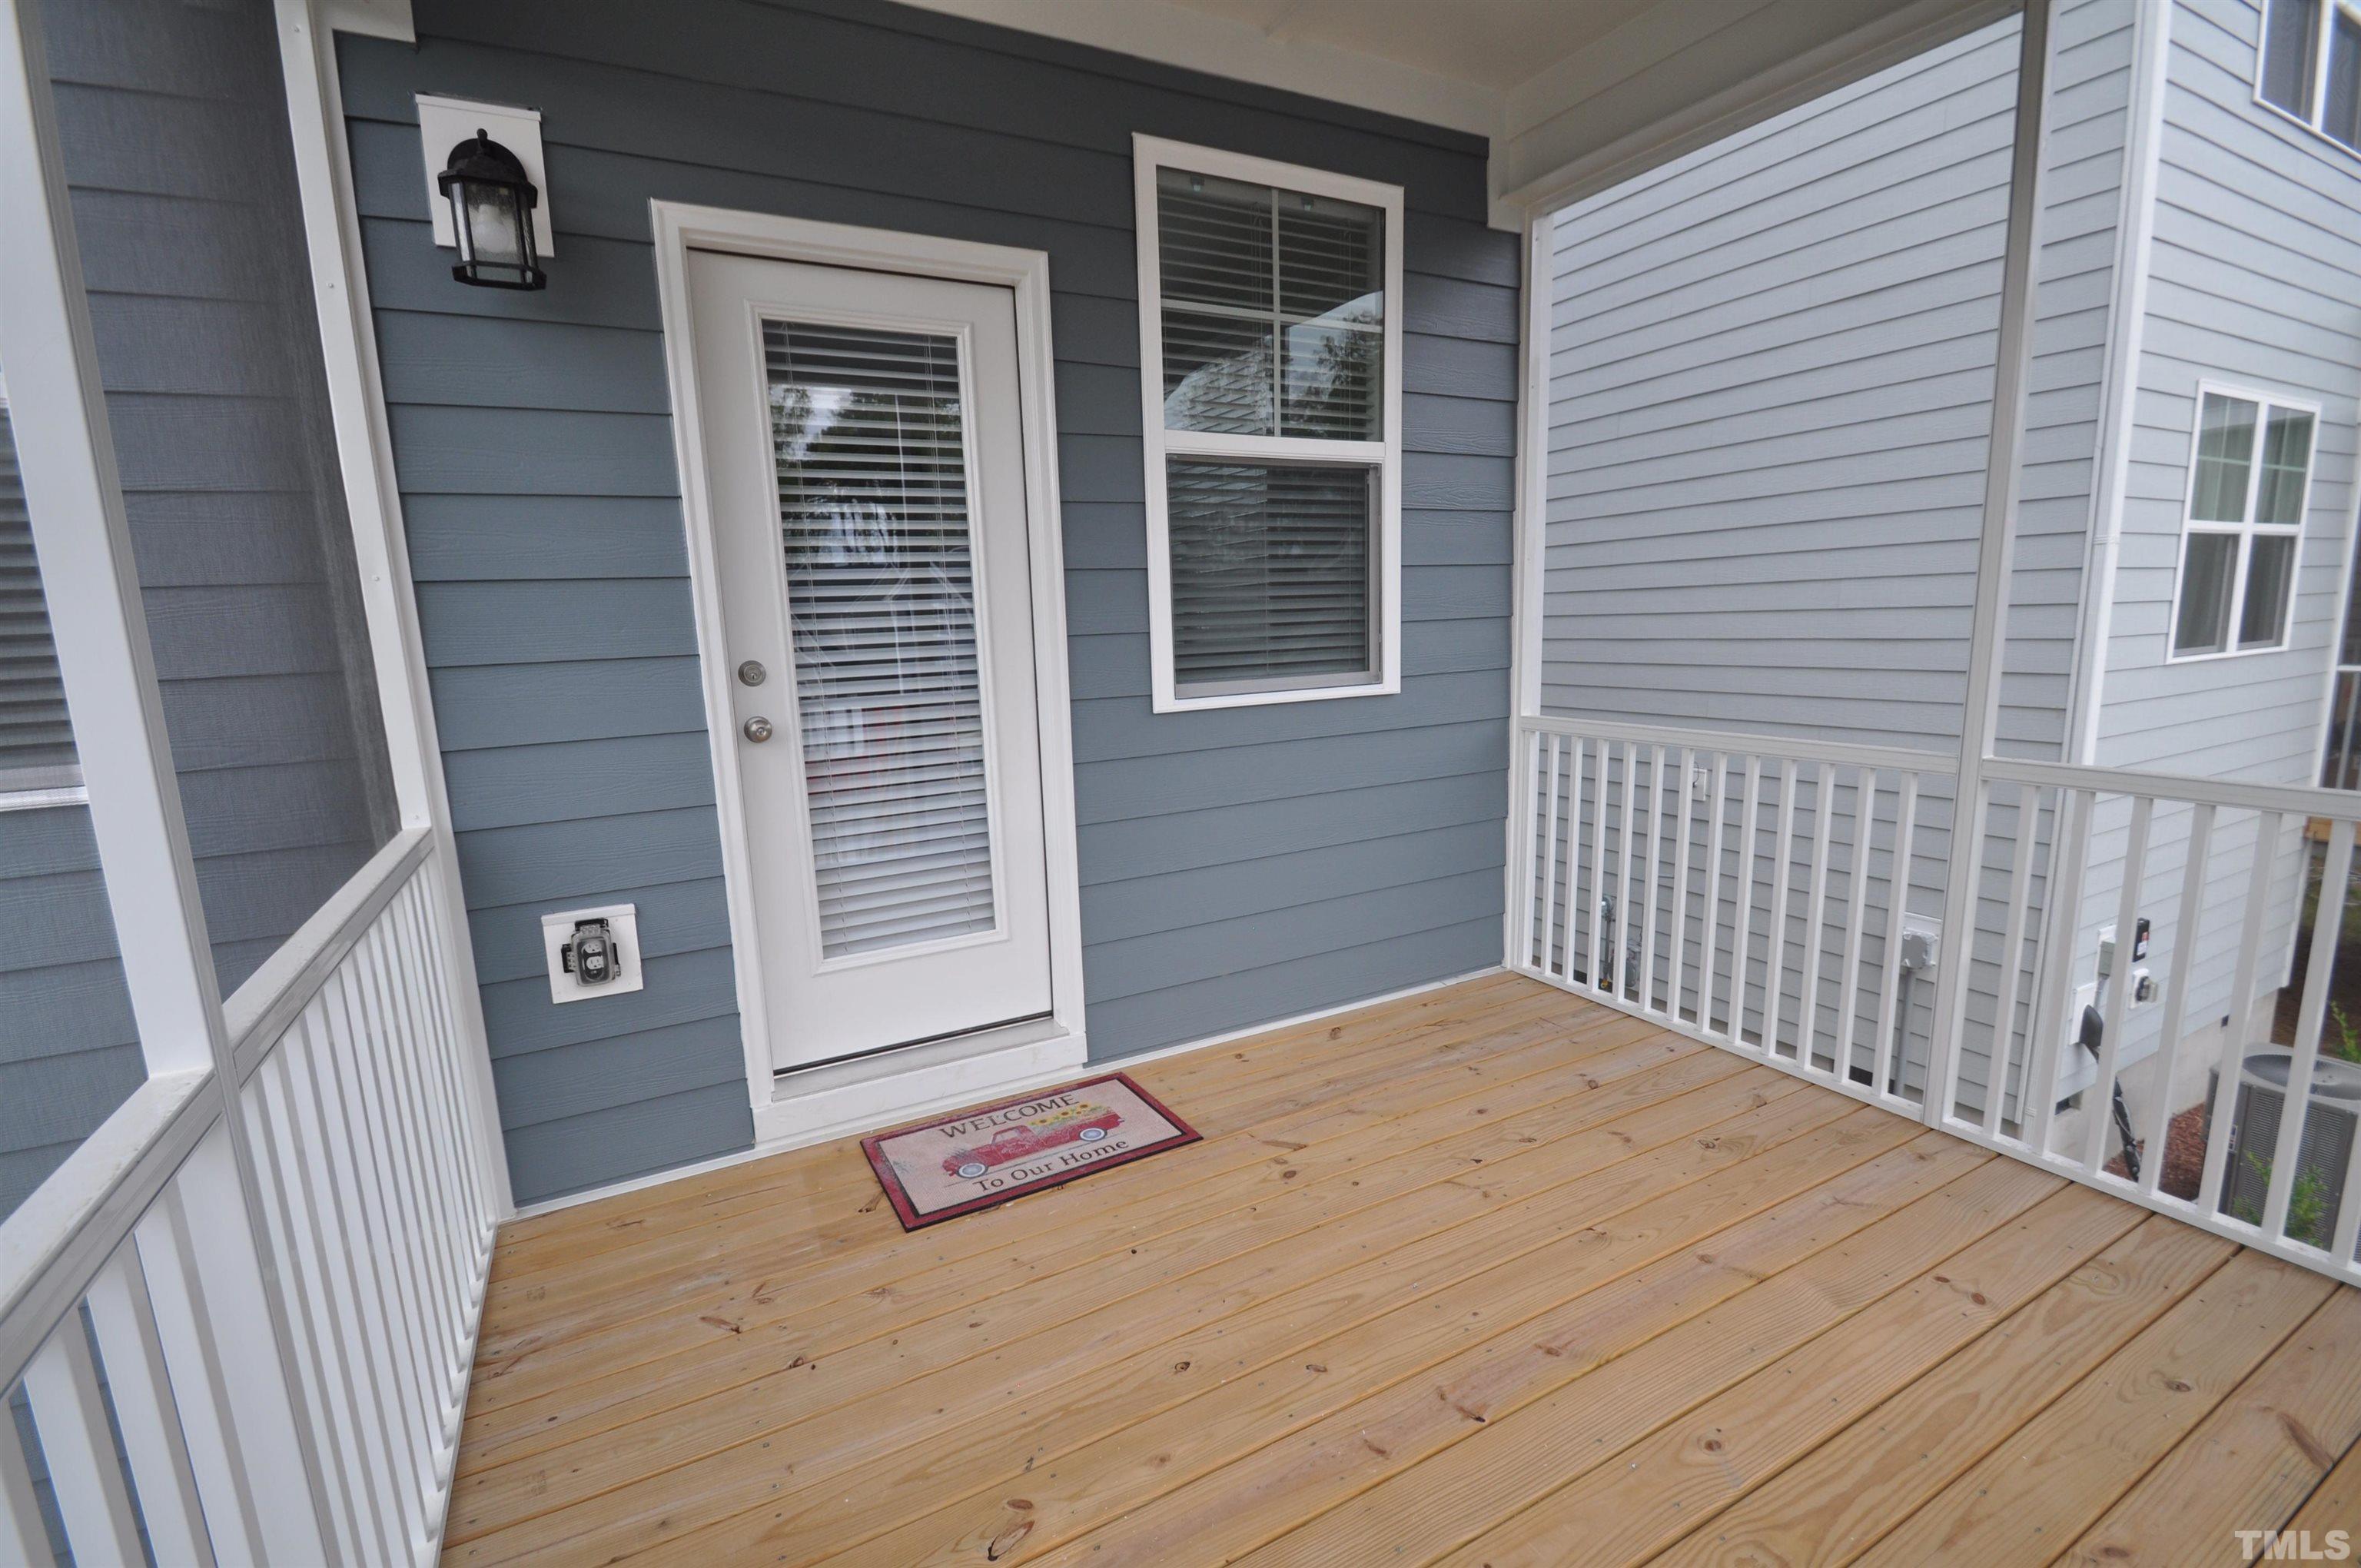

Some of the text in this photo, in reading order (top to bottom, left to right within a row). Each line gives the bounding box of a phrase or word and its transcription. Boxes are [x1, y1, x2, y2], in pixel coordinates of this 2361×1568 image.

[940, 1095, 1079, 1138] WELCOME
[973, 1141, 1129, 1192] To Our Home
